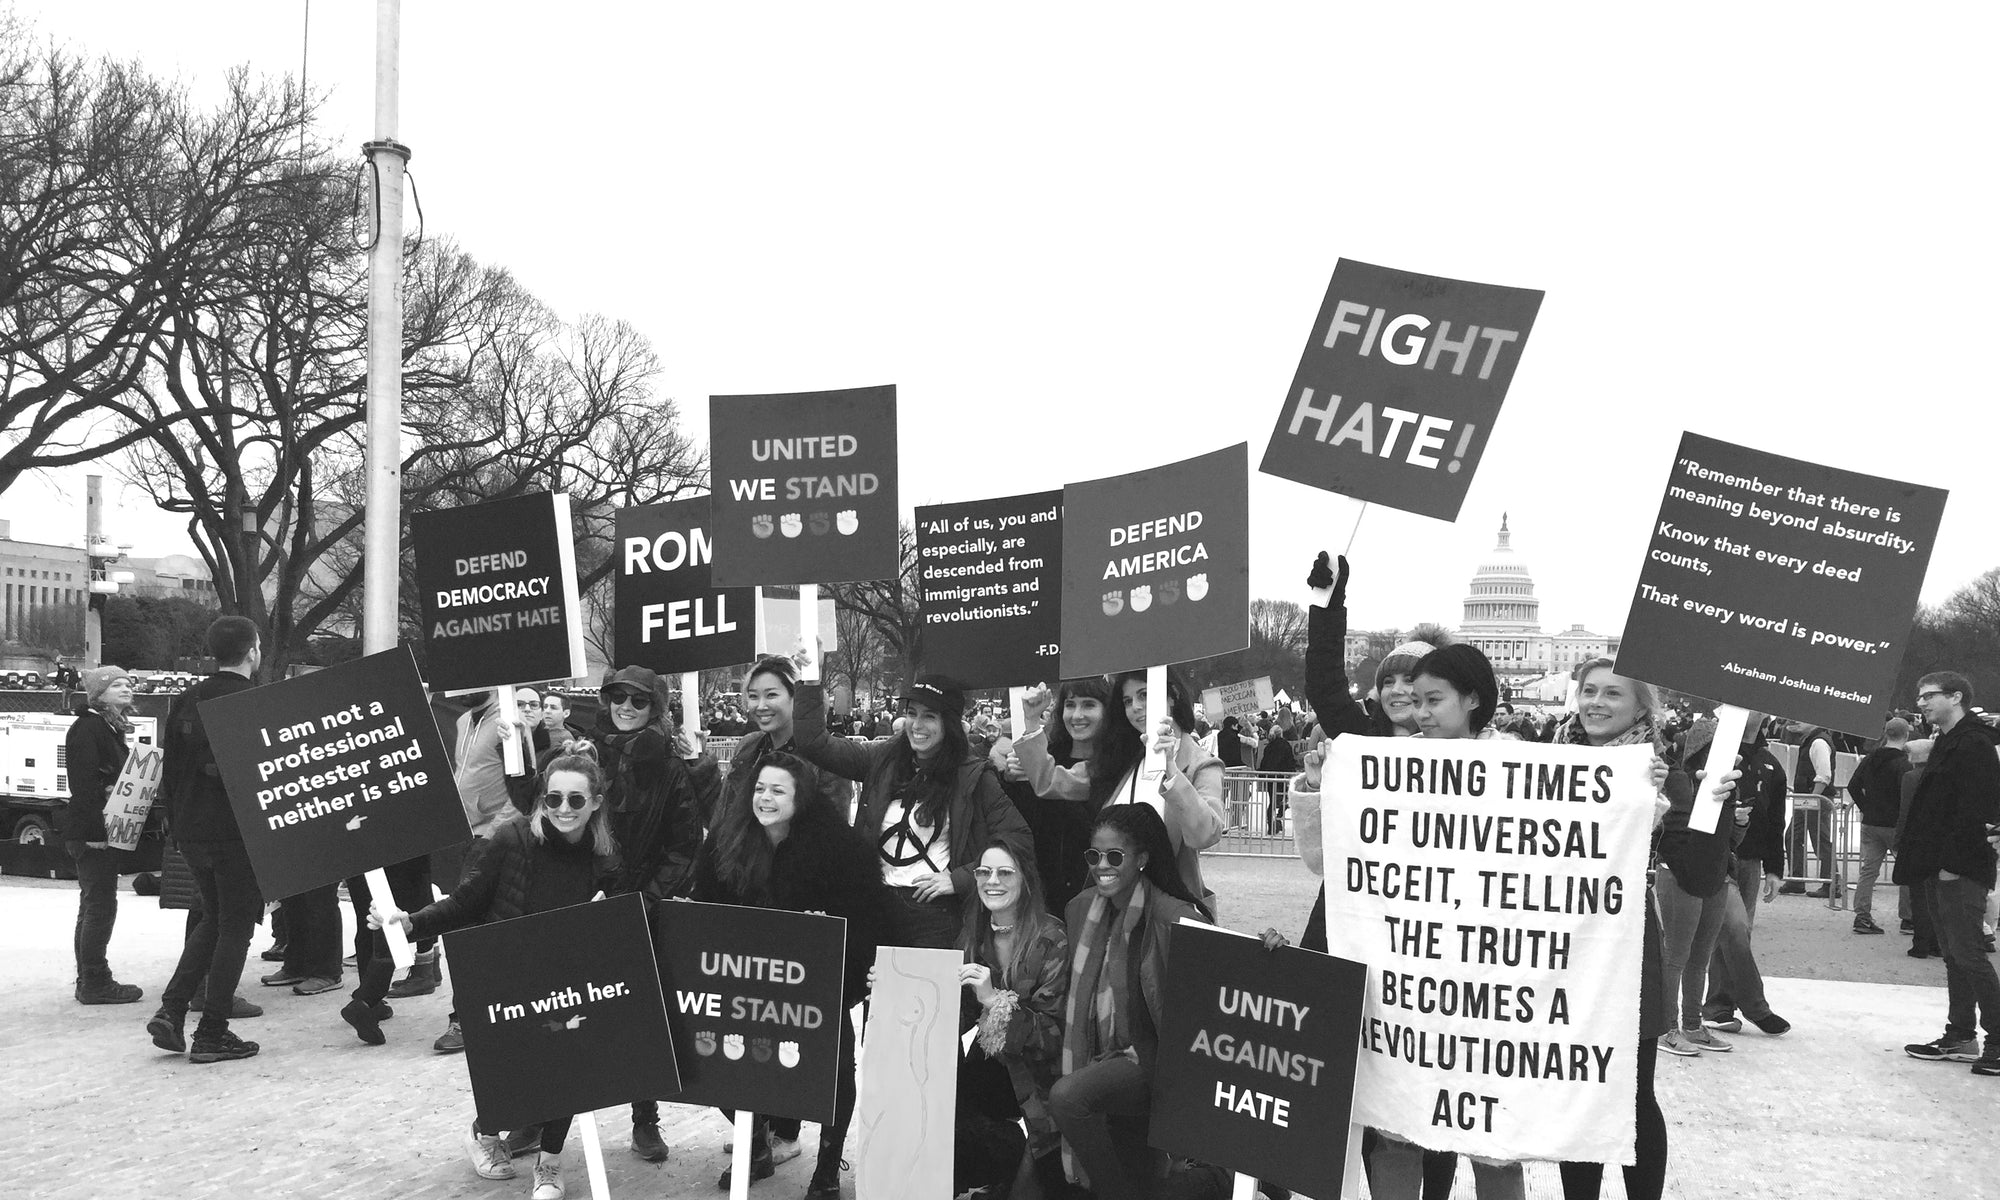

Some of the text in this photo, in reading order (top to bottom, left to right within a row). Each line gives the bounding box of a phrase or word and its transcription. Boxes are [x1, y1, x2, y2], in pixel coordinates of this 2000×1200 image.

[1323, 300, 1518, 379] FIGHT
[752, 435, 857, 461] UNITED
[1288, 387, 1475, 473] HATE!
[729, 473, 878, 501] WE STAND
[1679, 459, 1901, 522] “Remember that there is
[921, 519, 948, 534] “All
[954, 517, 969, 531] of
[974, 519, 994, 531] us,
[999, 515, 1025, 530] you
[1031, 506, 1056, 523] and
[1110, 511, 1202, 546] DEFEND
[1670, 486, 1915, 554] meaning beyond absurdity.
[456, 551, 527, 575] DEFEND
[922, 538, 1025, 559] especially, are
[923, 557, 1043, 579] descended from
[1103, 542, 1208, 580] AMERICA
[1652, 550, 1712, 575] counts,
[1659, 522, 1861, 582] Know that every deed
[437, 577, 549, 608] DEMOCRACY
[925, 577, 1039, 602] immigrants and
[434, 607, 559, 638] AGAINST HATE
[642, 594, 736, 643] FELL
[927, 601, 1038, 623] revolutionists.”
[1642, 584, 1890, 654] That every word is power.”
[1220, 689, 1256, 704] MEXICAN
[1721, 663, 1872, 704] -Abraham Joshua Heschel
[261, 702, 384, 746] I am not a
[125, 747, 162, 781] MY
[258, 716, 404, 781] professional
[116, 781, 134, 797] IS
[257, 739, 422, 810] protester and
[1362, 755, 1612, 803] DURING TIMES
[268, 771, 428, 830] neither is she
[1361, 808, 1606, 858] OF UNIVERSAL
[1347, 857, 1622, 914] DECEIT, TELLING
[1385, 916, 1569, 969] THE TRUTH
[701, 952, 805, 984] UNITED
[488, 982, 629, 1023] I’m with her.
[677, 991, 822, 1028] WE STAND
[1219, 987, 1309, 1031] UNITY
[1383, 970, 1569, 1024] BECOMES A
[1191, 1030, 1324, 1086] AGAINST
[1215, 1081, 1290, 1128] HATE
[1432, 1089, 1498, 1132] ACT
